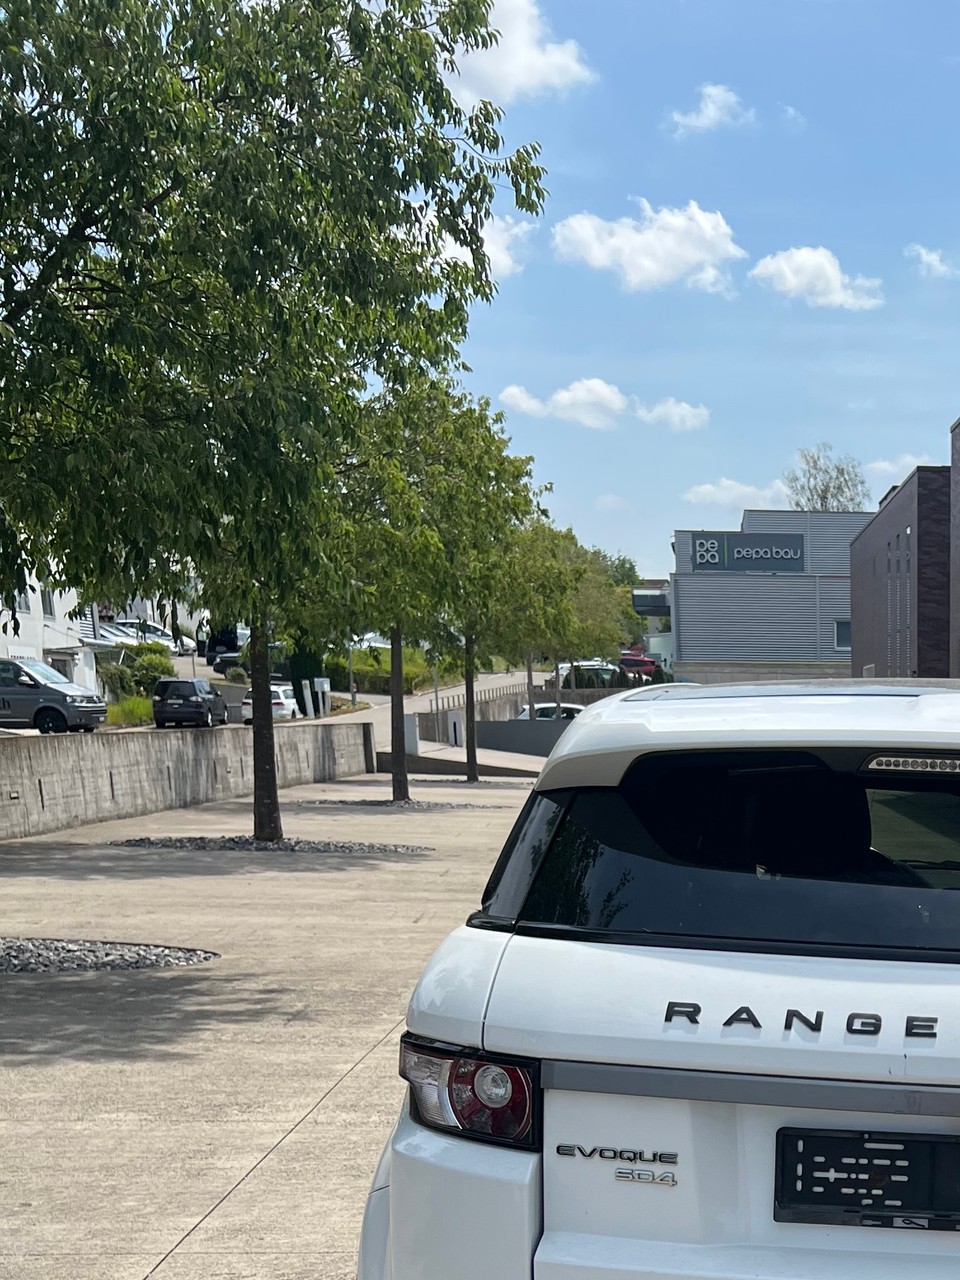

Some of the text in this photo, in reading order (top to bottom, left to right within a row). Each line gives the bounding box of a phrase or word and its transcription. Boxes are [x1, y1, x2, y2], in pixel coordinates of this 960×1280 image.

[734, 546, 801, 560] pepa bau
[664, 1000, 939, 1038] RANGE
[556, 1143, 679, 1165] EVOQUE
[615, 1167, 678, 1187] SD4
